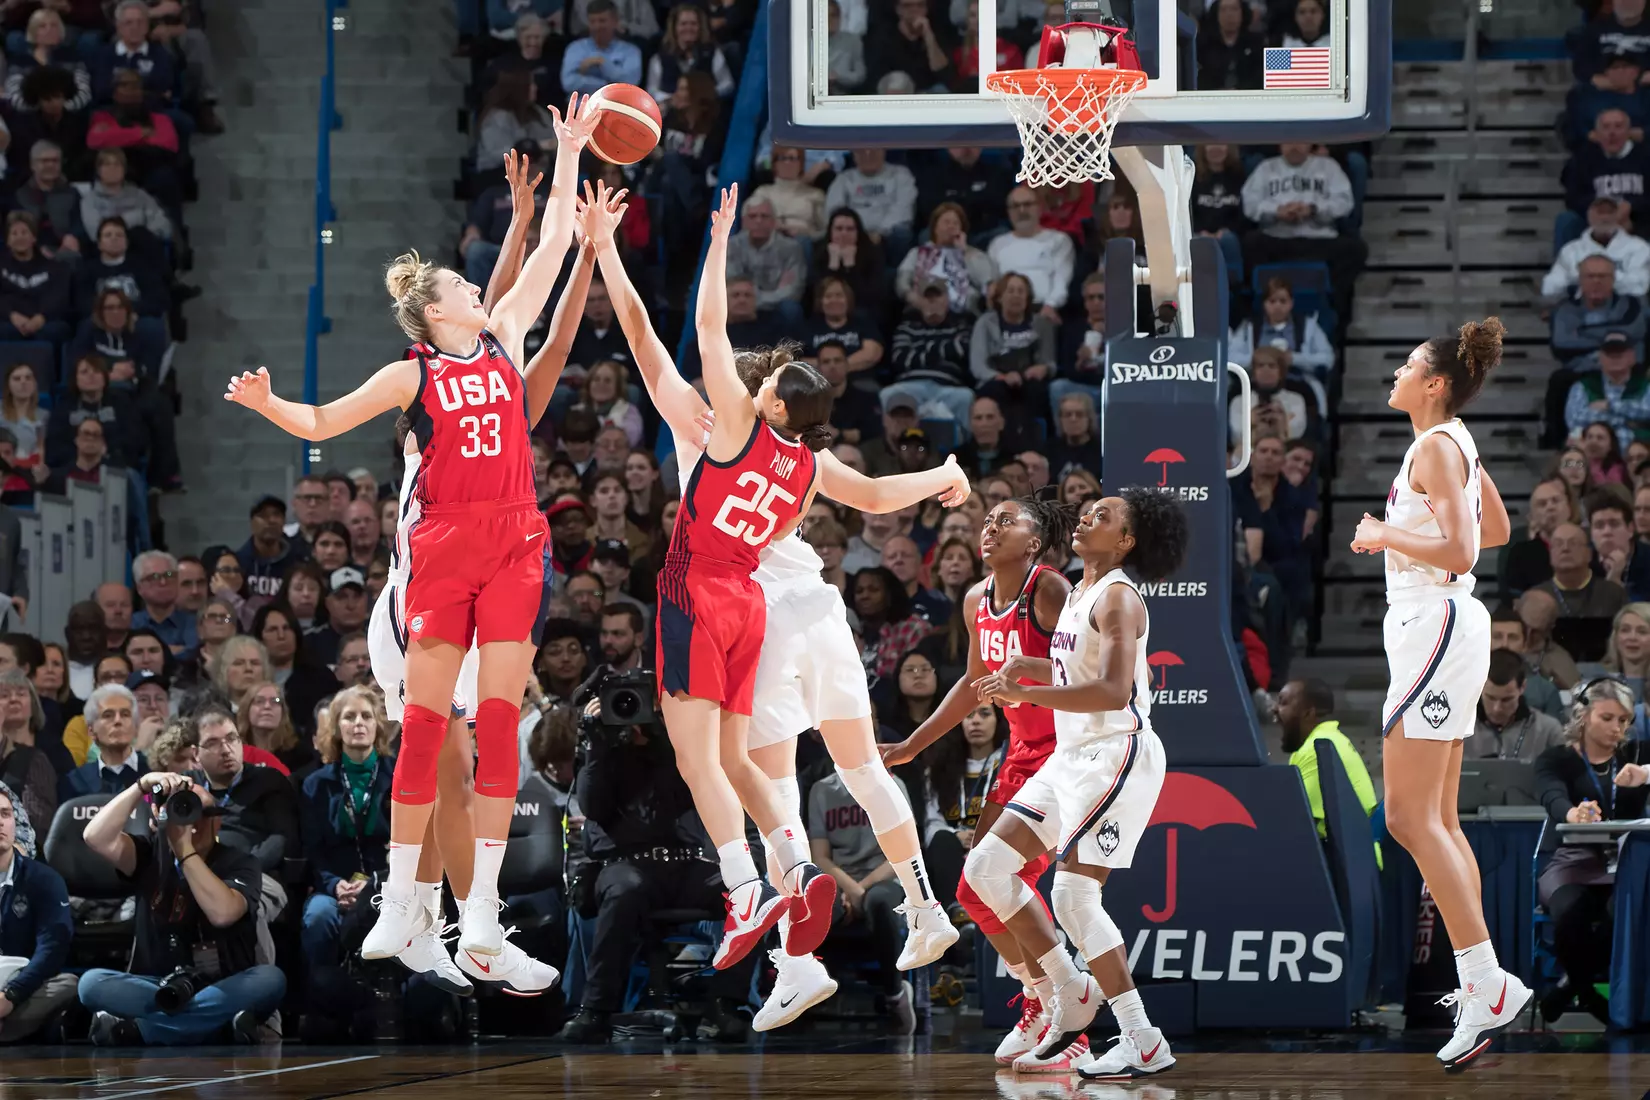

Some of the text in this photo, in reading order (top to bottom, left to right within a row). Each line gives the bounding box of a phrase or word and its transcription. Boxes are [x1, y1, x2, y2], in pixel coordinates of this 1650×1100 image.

[1111, 361, 1214, 384] SPALDING
[435, 370, 512, 412] USA
[459, 413, 502, 458] 33
[769, 449, 797, 480] PLUM
[712, 471, 797, 546] 25
[1134, 582, 1207, 597] AVELERS
[980, 628, 1023, 662] USA
[1051, 632, 1077, 652] ONN
[1149, 689, 1208, 704] VELERS
[996, 929, 1345, 983] VELERS
